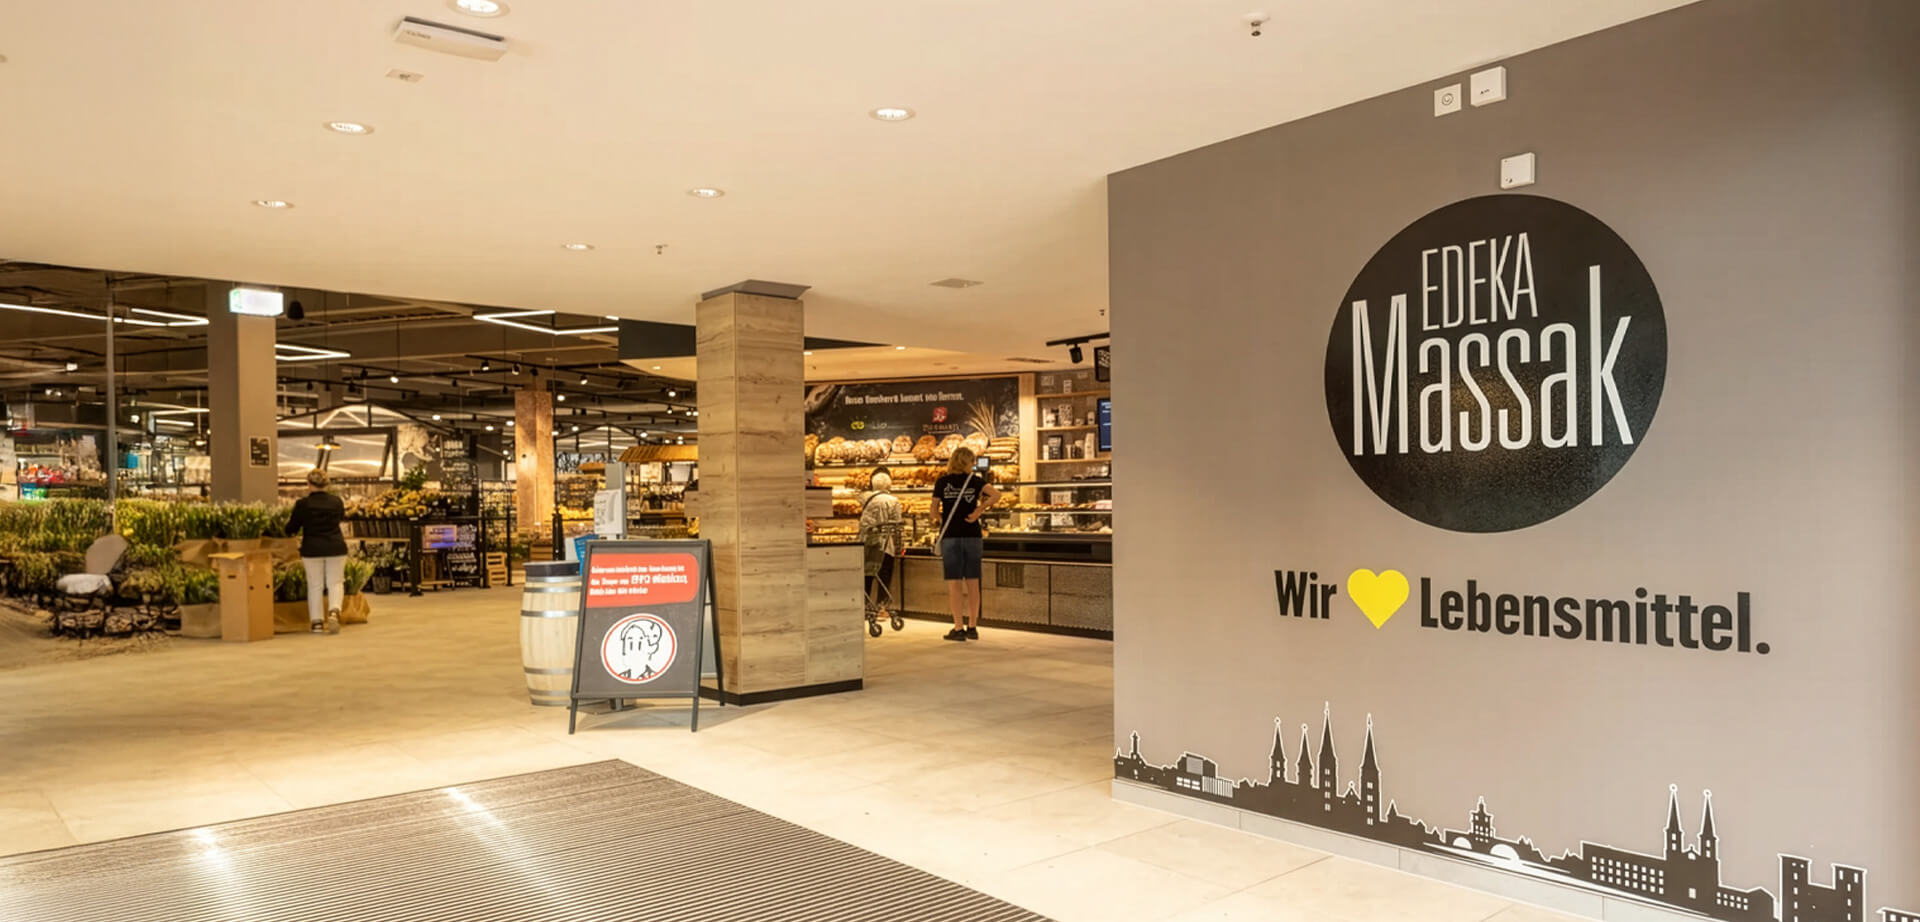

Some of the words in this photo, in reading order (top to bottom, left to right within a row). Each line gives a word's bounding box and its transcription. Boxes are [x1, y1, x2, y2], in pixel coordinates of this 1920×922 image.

[1422, 232, 1538, 331] EDEKA
[1352, 265, 1634, 456] Massak
[1274, 570, 1337, 619] Wir
[1421, 577, 1771, 654] Lebensmittel.
